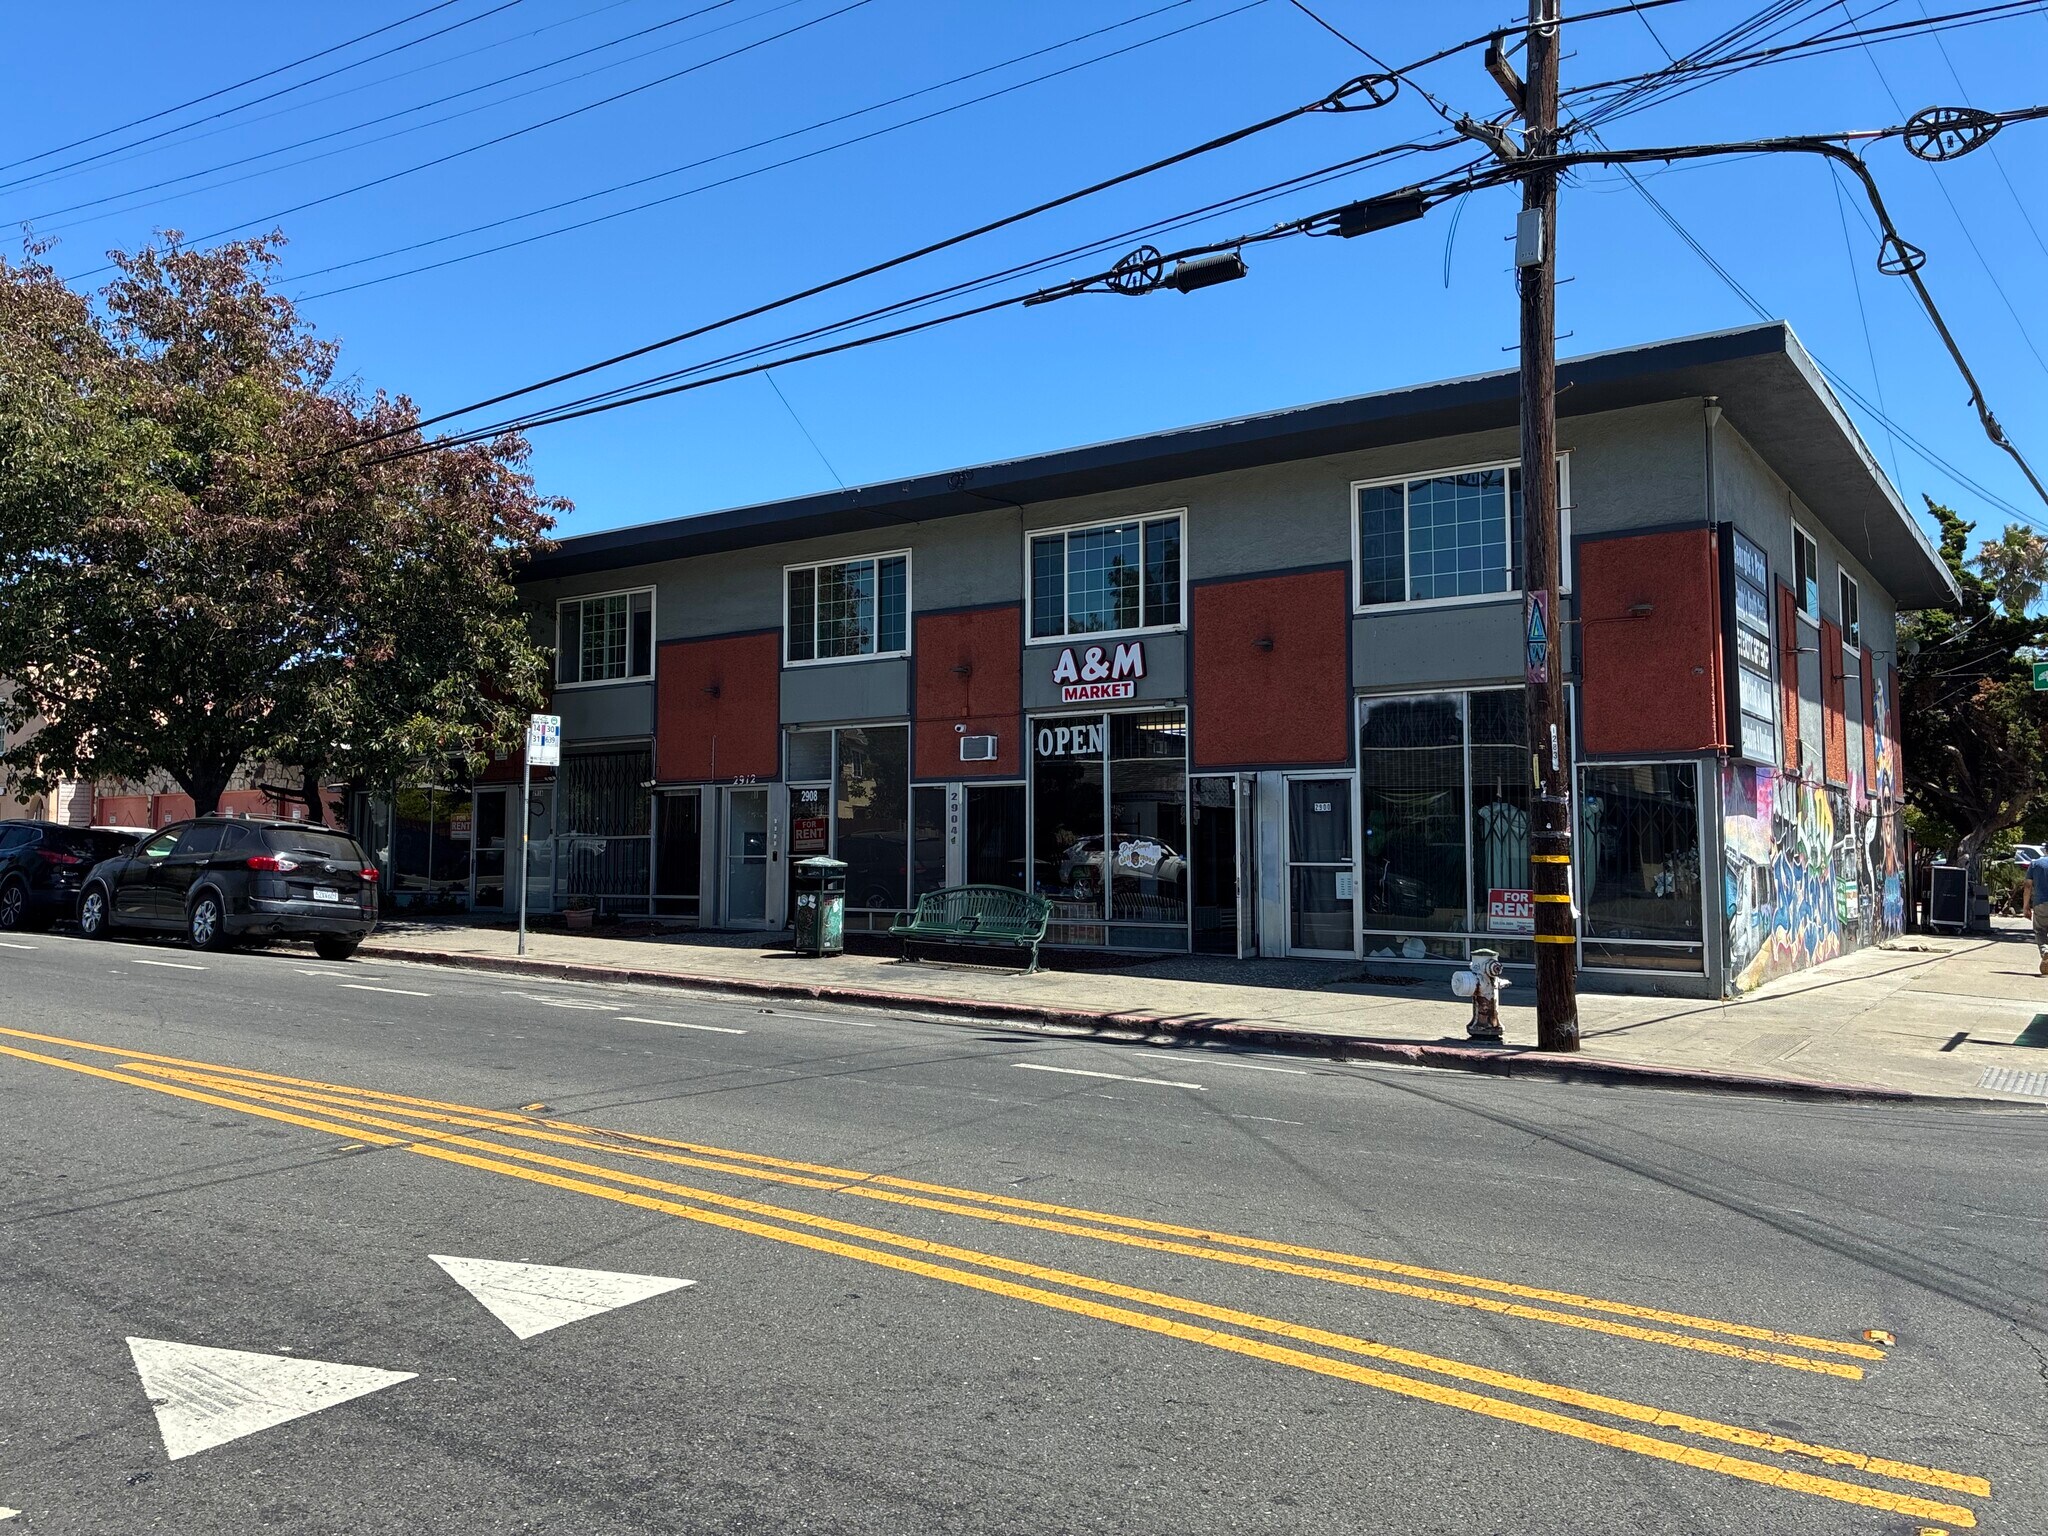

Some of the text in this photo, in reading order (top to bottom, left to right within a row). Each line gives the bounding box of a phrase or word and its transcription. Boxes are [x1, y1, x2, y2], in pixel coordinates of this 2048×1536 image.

[1052, 641, 1147, 683] A&M
[1064, 683, 1132, 701] MARKET
[1038, 724, 1104, 757] OPEN
[733, 774, 756, 785] 2912
[801, 790, 818, 801] 2908
[451, 822, 471, 830] RENT
[796, 828, 824, 839] RENT
[1503, 892, 1529, 902] FOR
